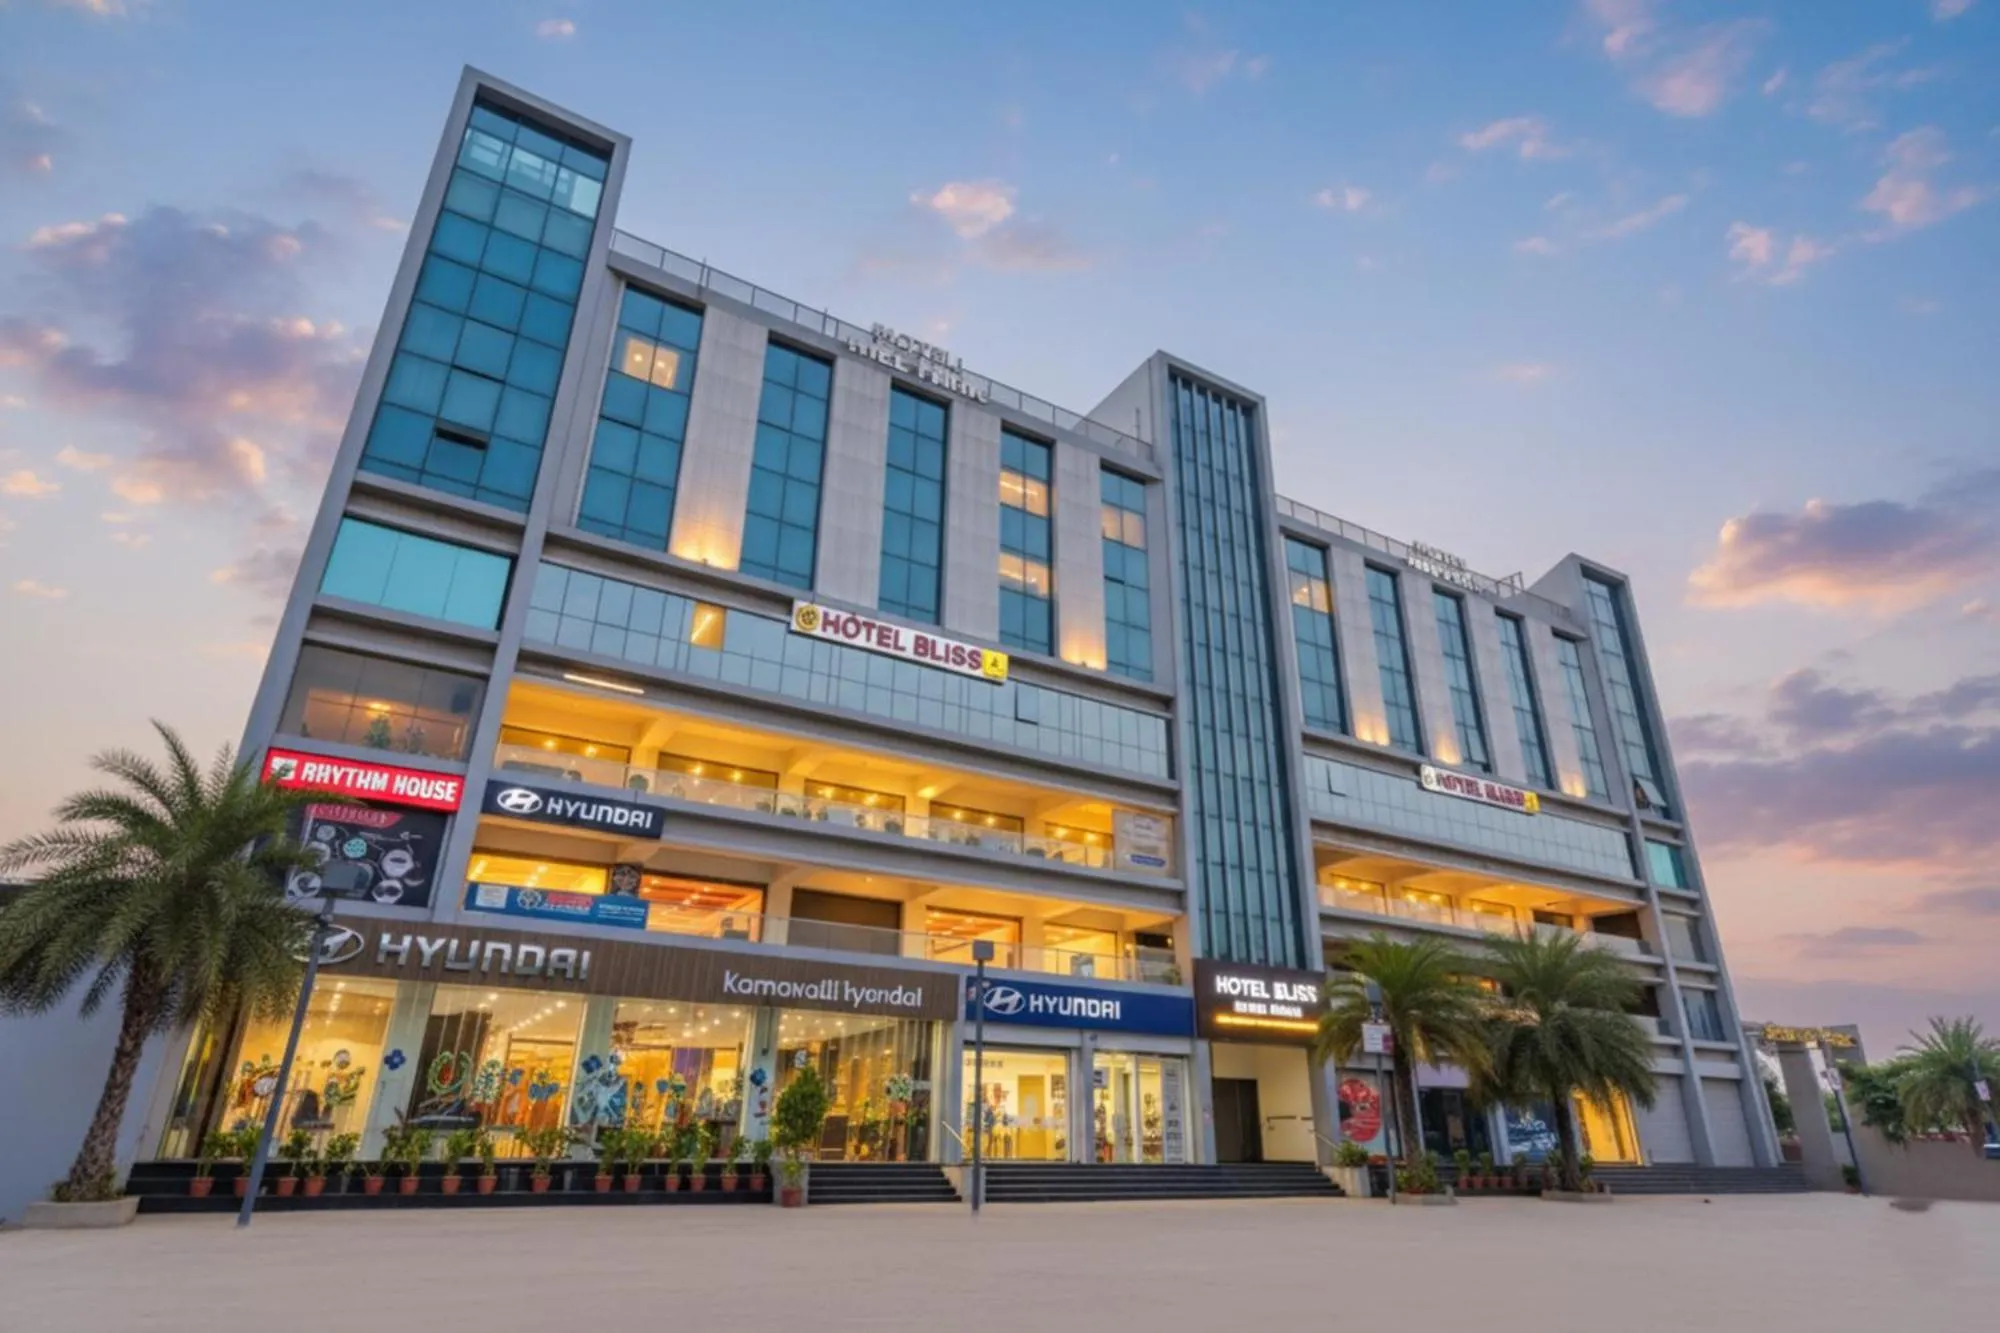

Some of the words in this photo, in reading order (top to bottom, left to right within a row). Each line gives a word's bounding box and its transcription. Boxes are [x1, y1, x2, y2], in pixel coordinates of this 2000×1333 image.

[821, 611, 906, 651] HOTEL
[913, 634, 982, 670] BLISS
[301, 761, 389, 792] RHYTHM
[392, 775, 459, 802] HOUSE
[546, 797, 653, 829] HYUNDAI
[377, 932, 591, 980] HYUNDAI
[1215, 974, 1271, 999] HOTEL
[1029, 993, 1121, 1020] HYUNDAI
